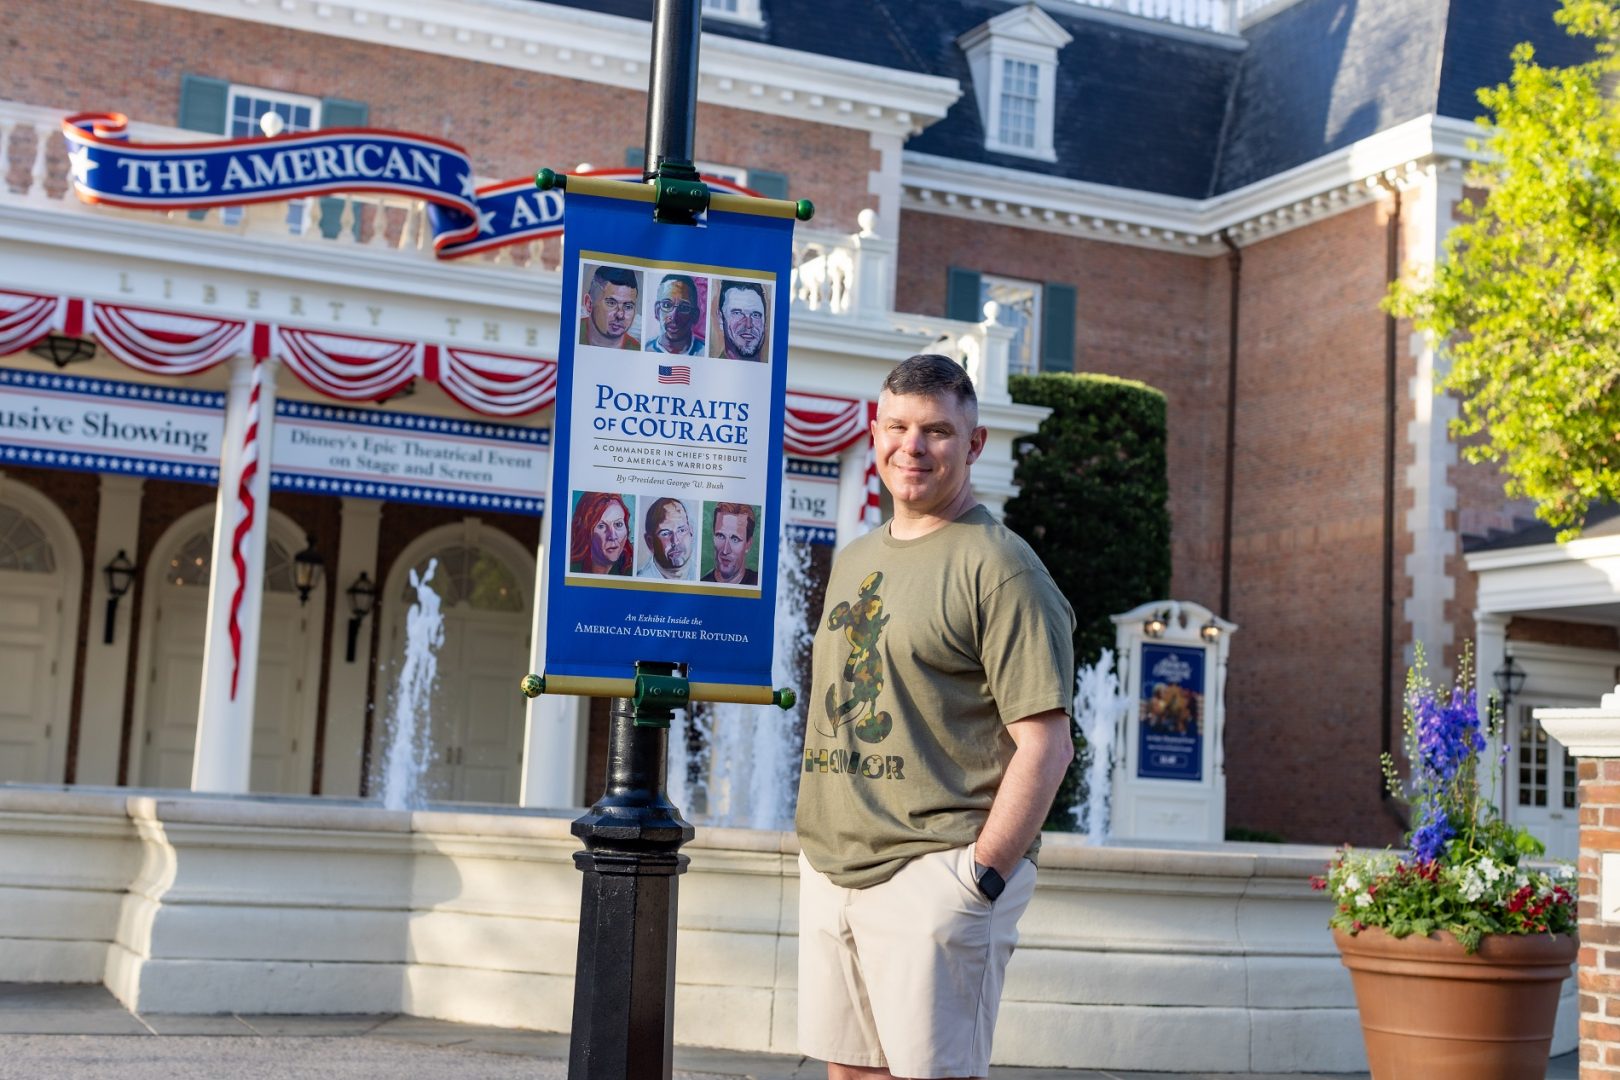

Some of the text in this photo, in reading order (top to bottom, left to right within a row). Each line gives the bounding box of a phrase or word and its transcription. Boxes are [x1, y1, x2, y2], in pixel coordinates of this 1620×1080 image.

[117, 143, 442, 195] THE AMERICAN
[118, 271, 383, 327] LIBERTY
[595, 384, 750, 422] PORTRAITS
[82, 410, 209, 453] Showing
[593, 416, 749, 445] OF COURAGE
[290, 428, 533, 470] Disney's Epic Theatrical Event
[602, 445, 661, 456] COMMANDER
[664, 449, 674, 457] IN
[676, 451, 711, 460] CHIEF'S
[713, 453, 748, 464] TRIBUTE
[612, 455, 723, 471] TO AMERICA'S WARRIORS
[329, 453, 493, 482] on Stage and Screen
[616, 474, 724, 490] By President George W. Bush
[574, 621, 749, 643] AMERICAN ADVENTURE ROTUNDA
[625, 613, 703, 626] An Exhibit Inside the
